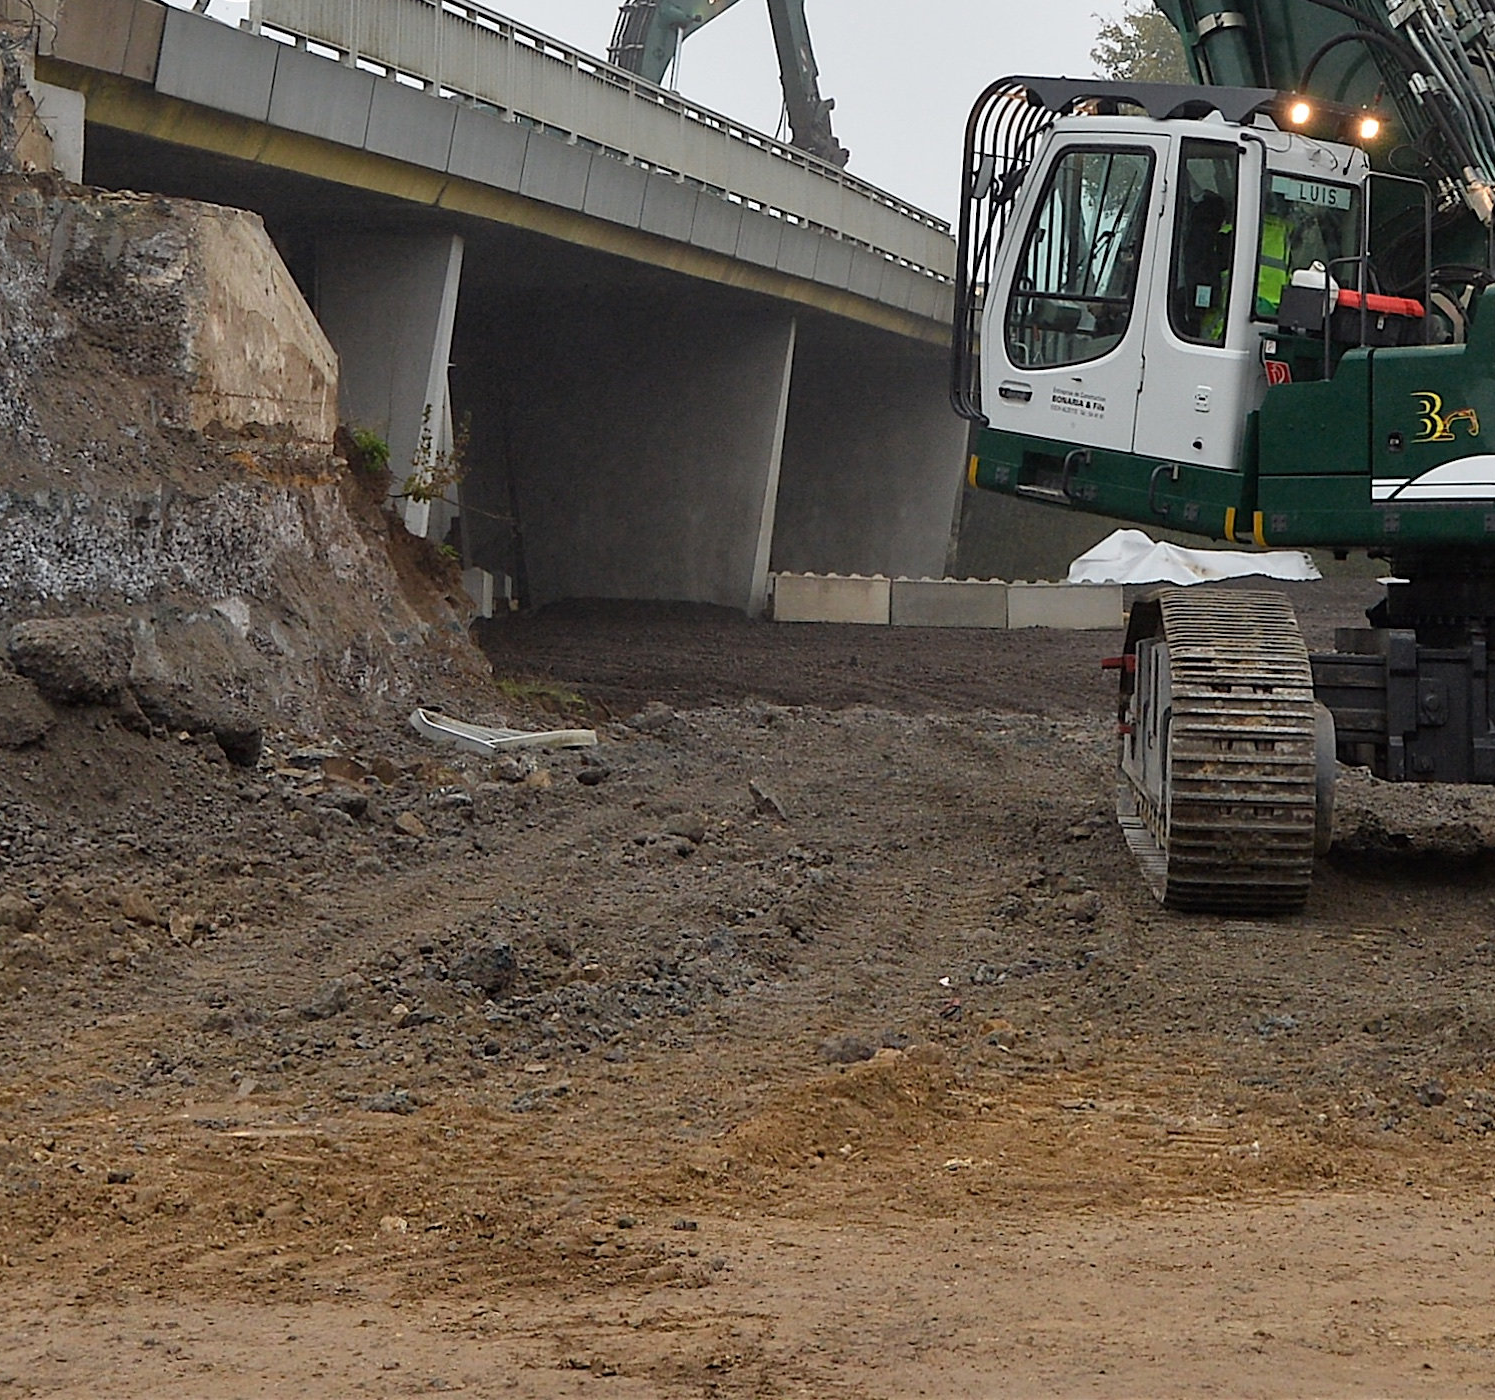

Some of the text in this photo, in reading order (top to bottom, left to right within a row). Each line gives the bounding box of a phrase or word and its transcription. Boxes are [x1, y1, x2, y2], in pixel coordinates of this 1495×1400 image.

[1299, 183, 1337, 205] LUIS
[1052, 395, 1105, 411] BONARIA & Fils
